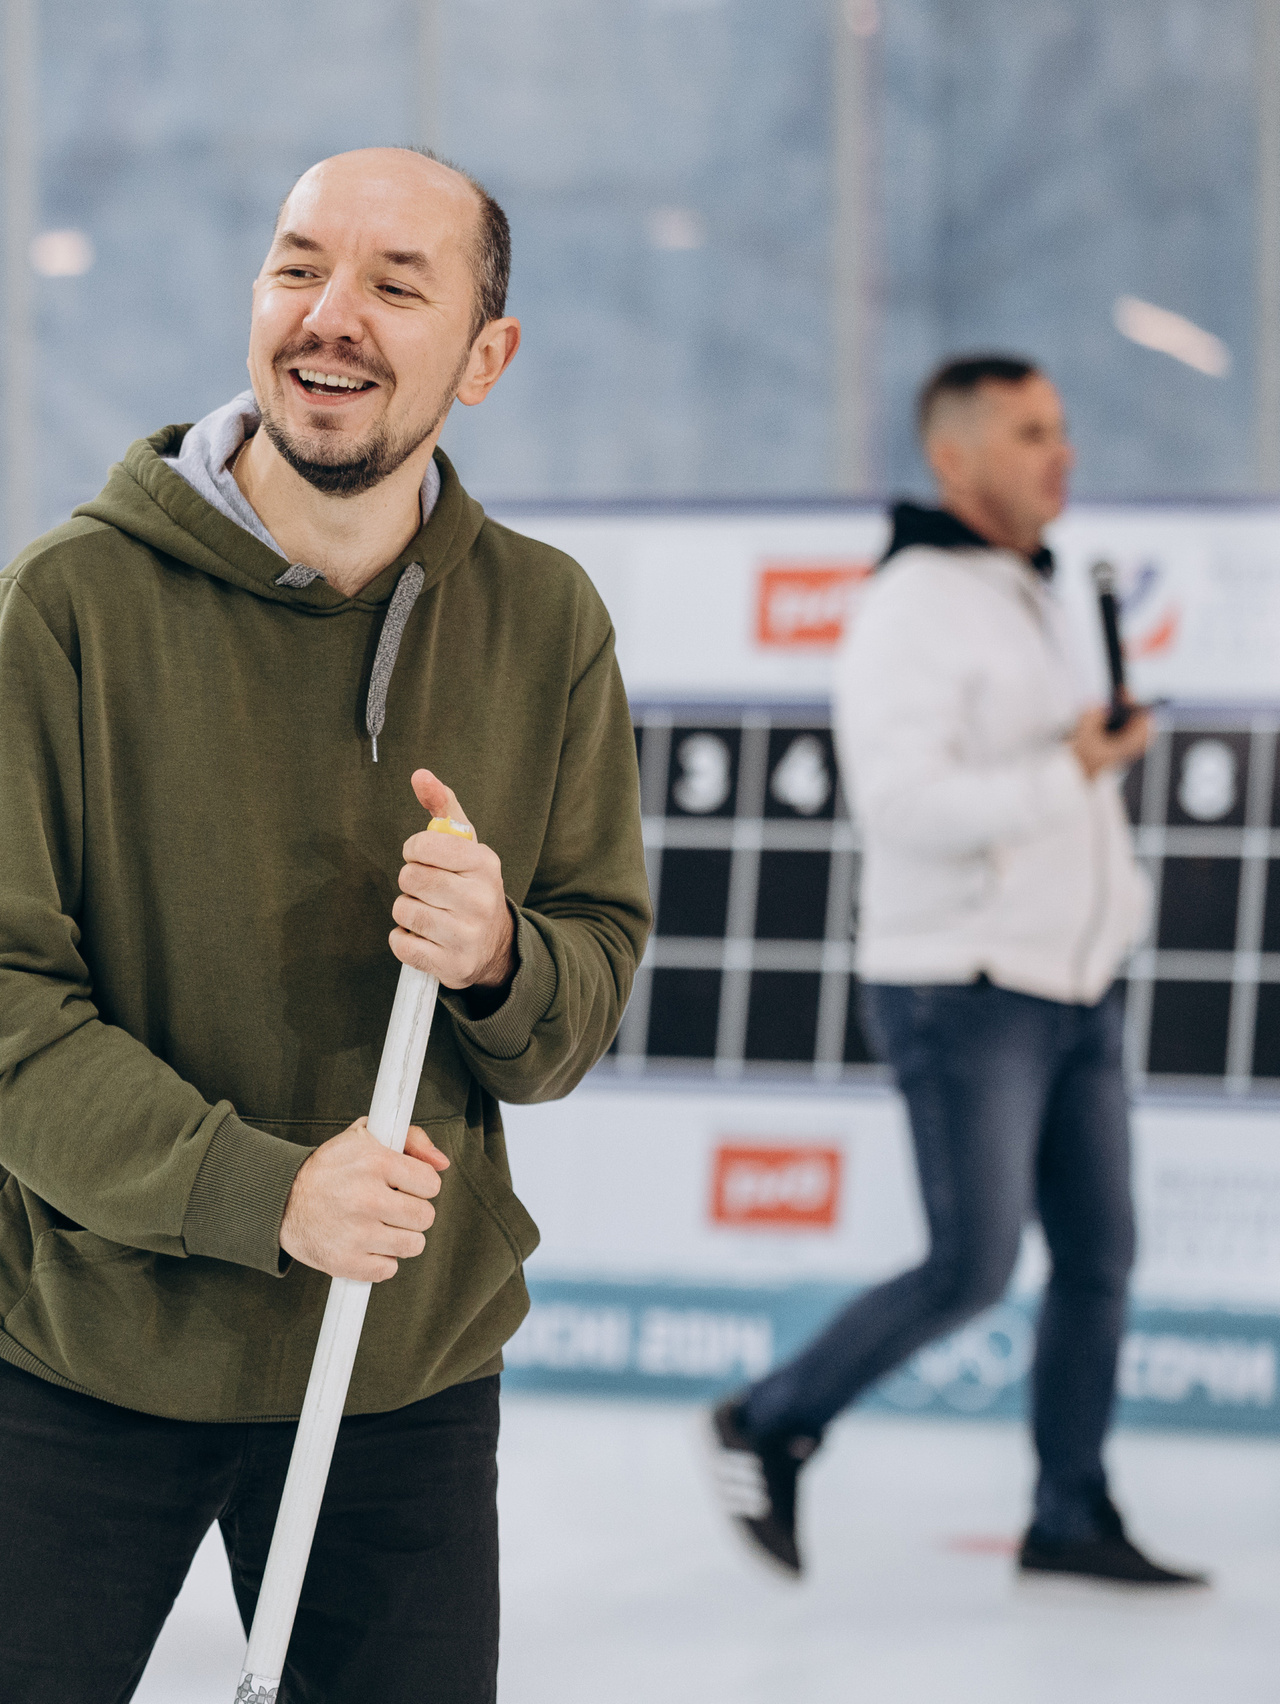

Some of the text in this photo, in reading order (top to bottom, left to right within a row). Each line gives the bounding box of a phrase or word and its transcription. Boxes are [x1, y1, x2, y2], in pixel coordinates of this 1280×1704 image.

[674, 731, 1236, 820] 3 4 8
